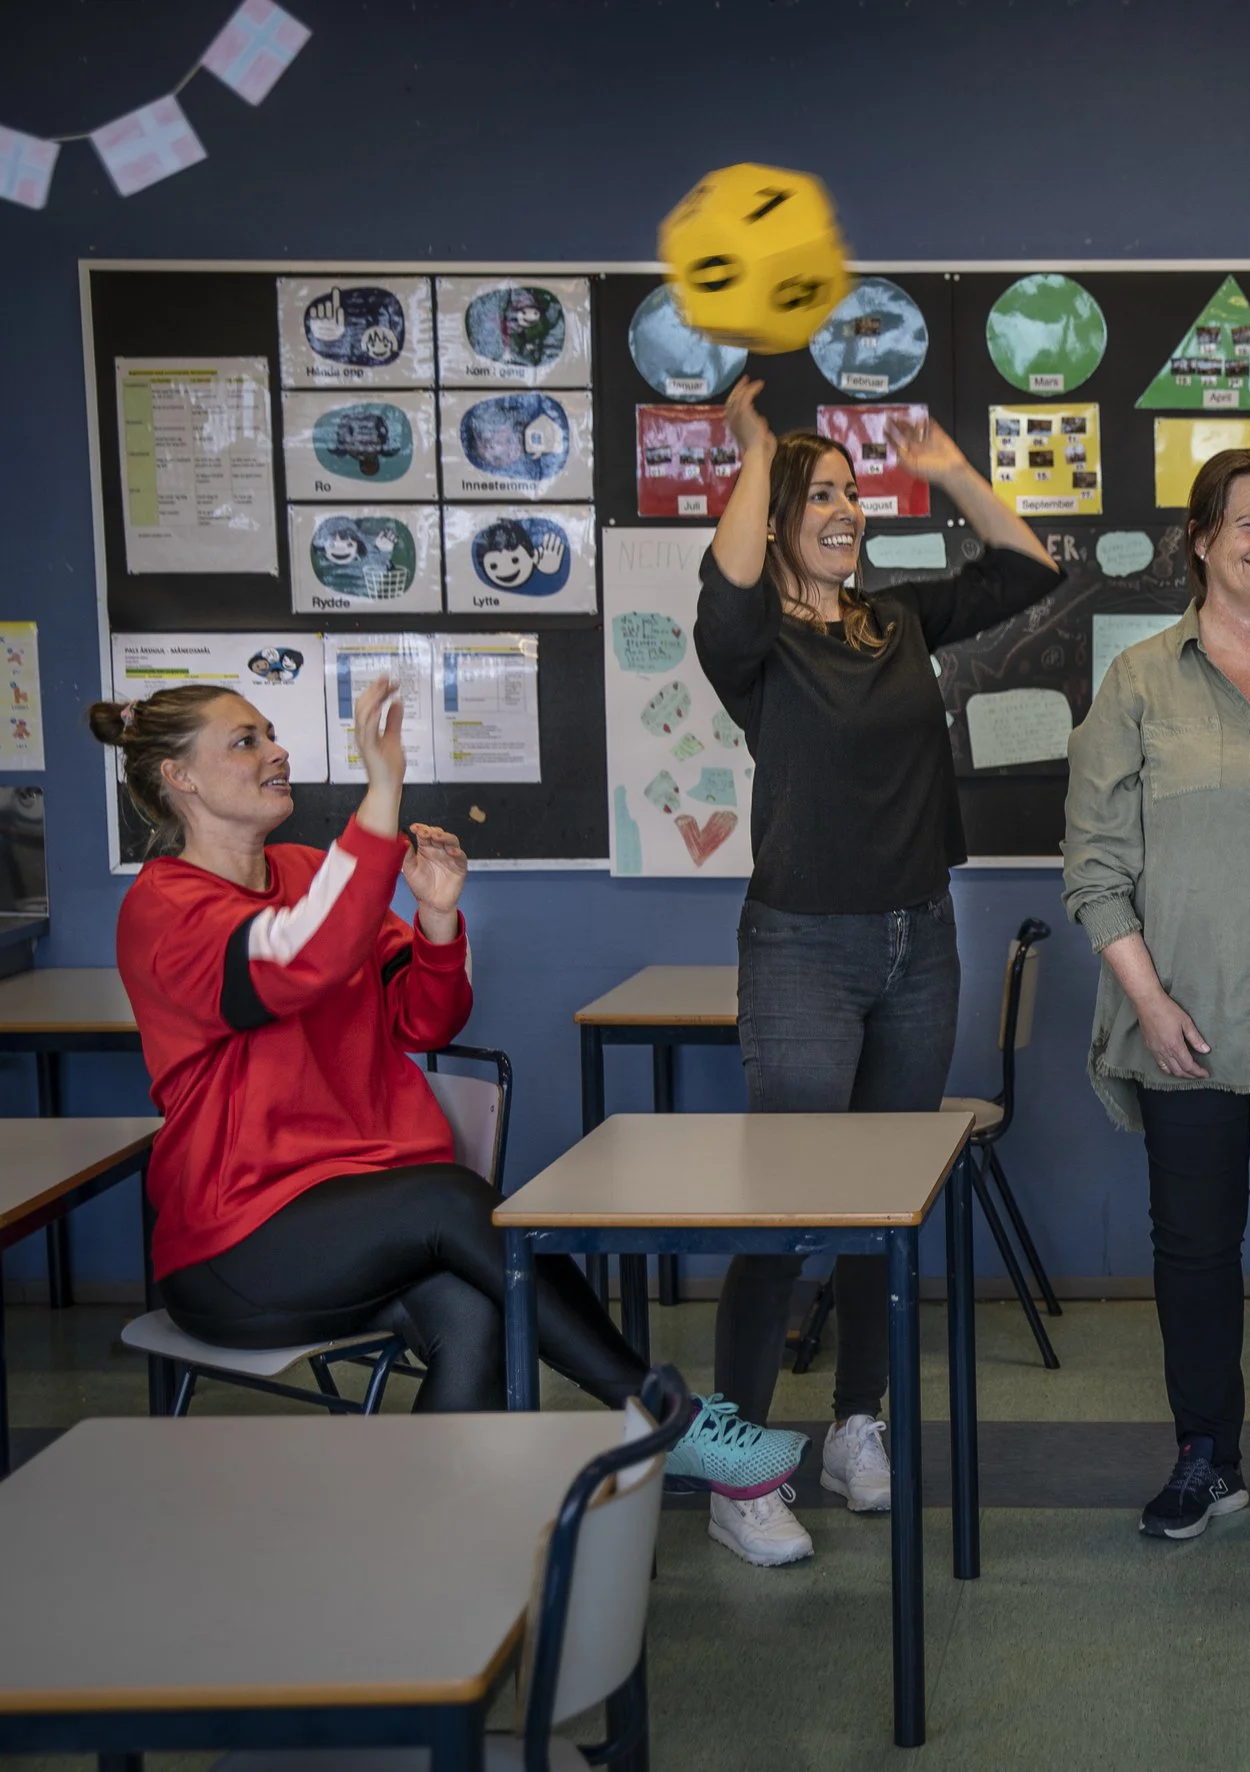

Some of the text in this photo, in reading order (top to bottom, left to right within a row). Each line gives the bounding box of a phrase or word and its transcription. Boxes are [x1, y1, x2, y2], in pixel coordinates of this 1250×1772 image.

[846, 375, 885, 388] Februar
[1034, 377, 1059, 387] Mars
[1210, 392, 1233, 403] April
[315, 480, 331, 492] Ro
[684, 501, 700, 511] Juli
[859, 501, 893, 511] August
[1022, 499, 1074, 510] September
[312, 596, 351, 610] Rydde
[473, 596, 500, 608] Lytte
